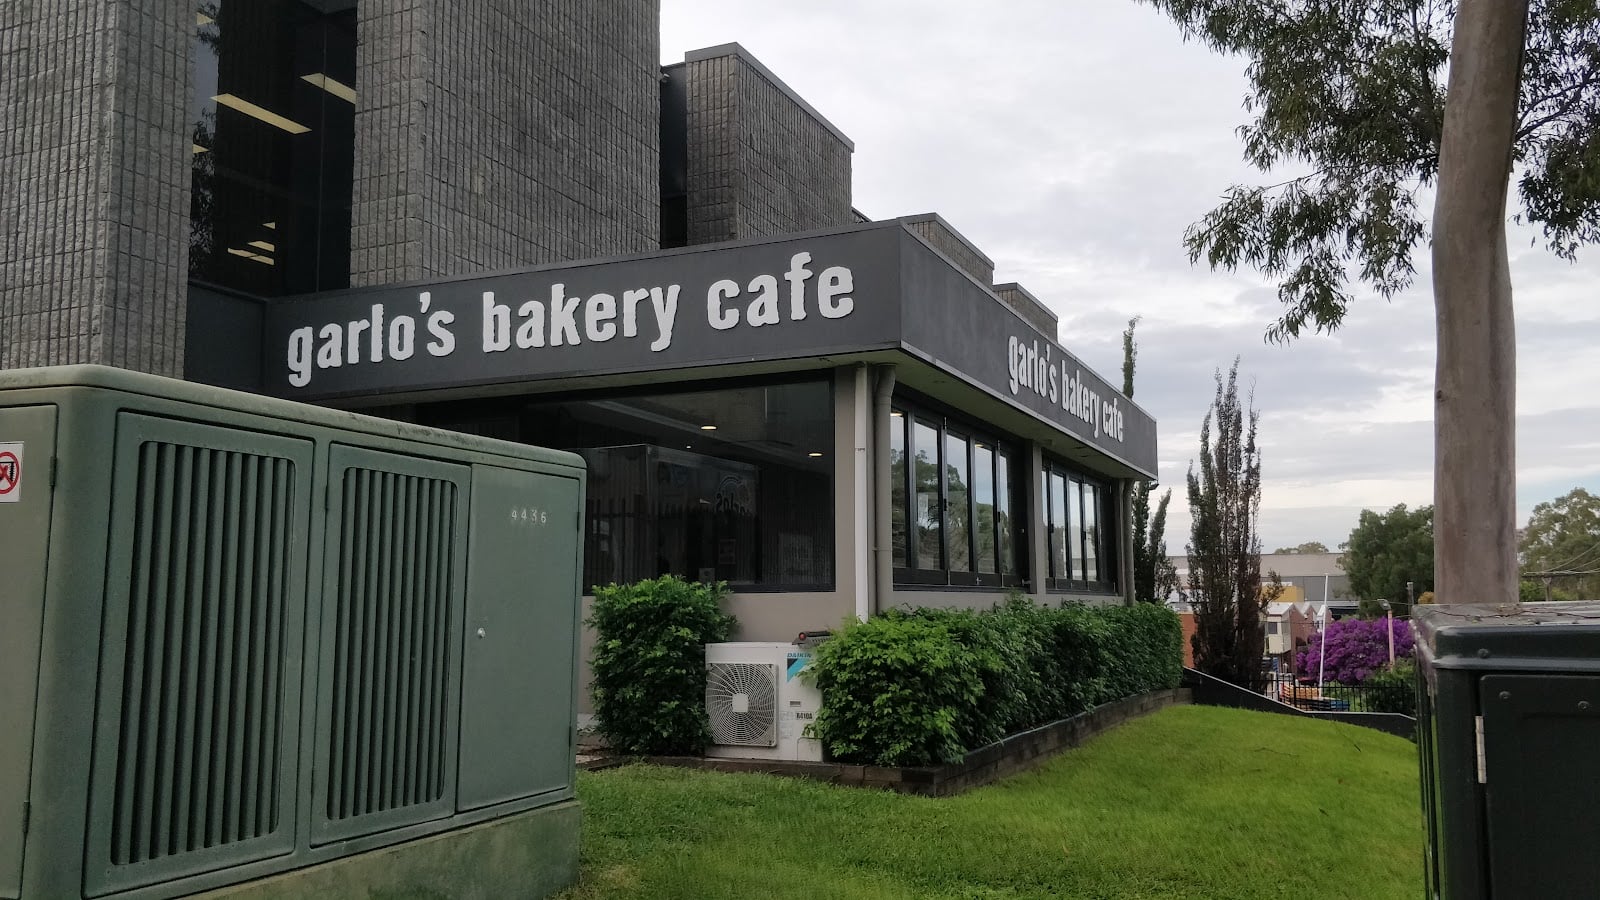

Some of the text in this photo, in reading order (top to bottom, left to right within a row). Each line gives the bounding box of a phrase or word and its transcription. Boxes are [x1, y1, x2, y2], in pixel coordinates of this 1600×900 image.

[288, 251, 854, 387] garlo's bakery cafe
[1008, 335, 1123, 442] garlo's bakery cafe
[511, 508, 547, 524] 4436
